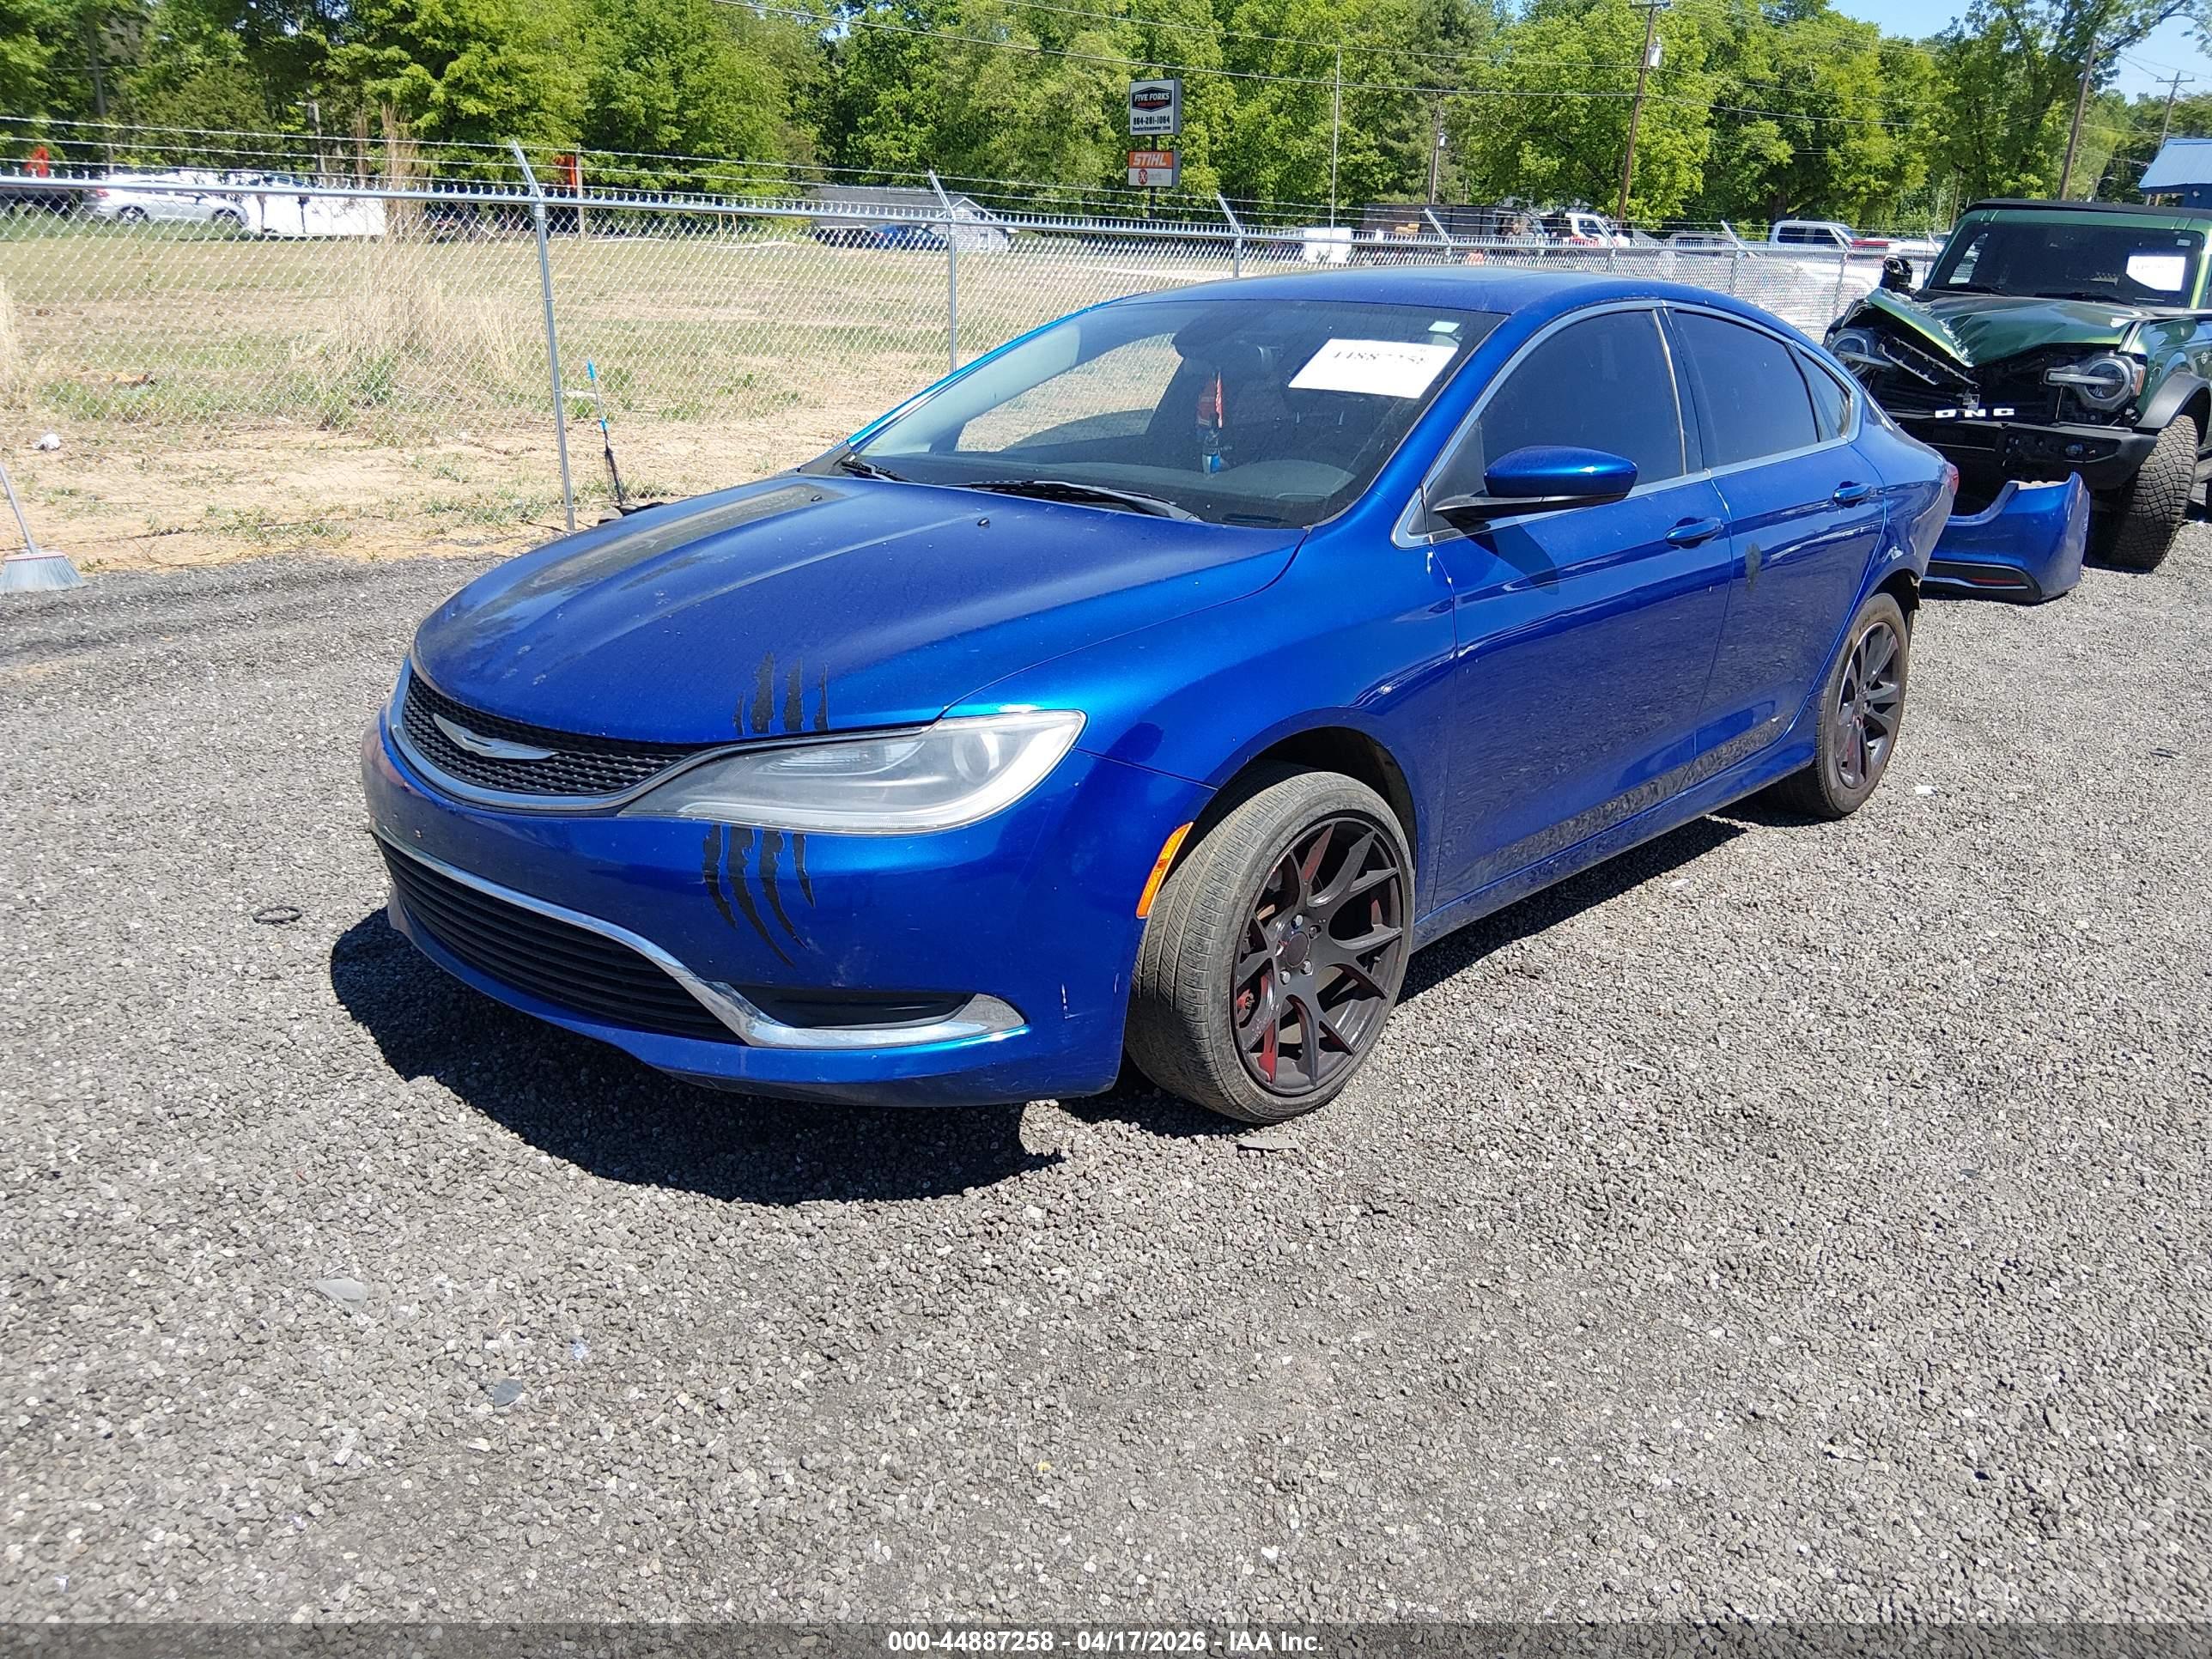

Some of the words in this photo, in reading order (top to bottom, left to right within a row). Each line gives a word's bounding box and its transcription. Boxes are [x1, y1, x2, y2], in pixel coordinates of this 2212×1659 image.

[1134, 94, 1148, 102] FIVE
[1149, 93, 1170, 101] FORKS
[1133, 153, 1167, 166] STIHL
